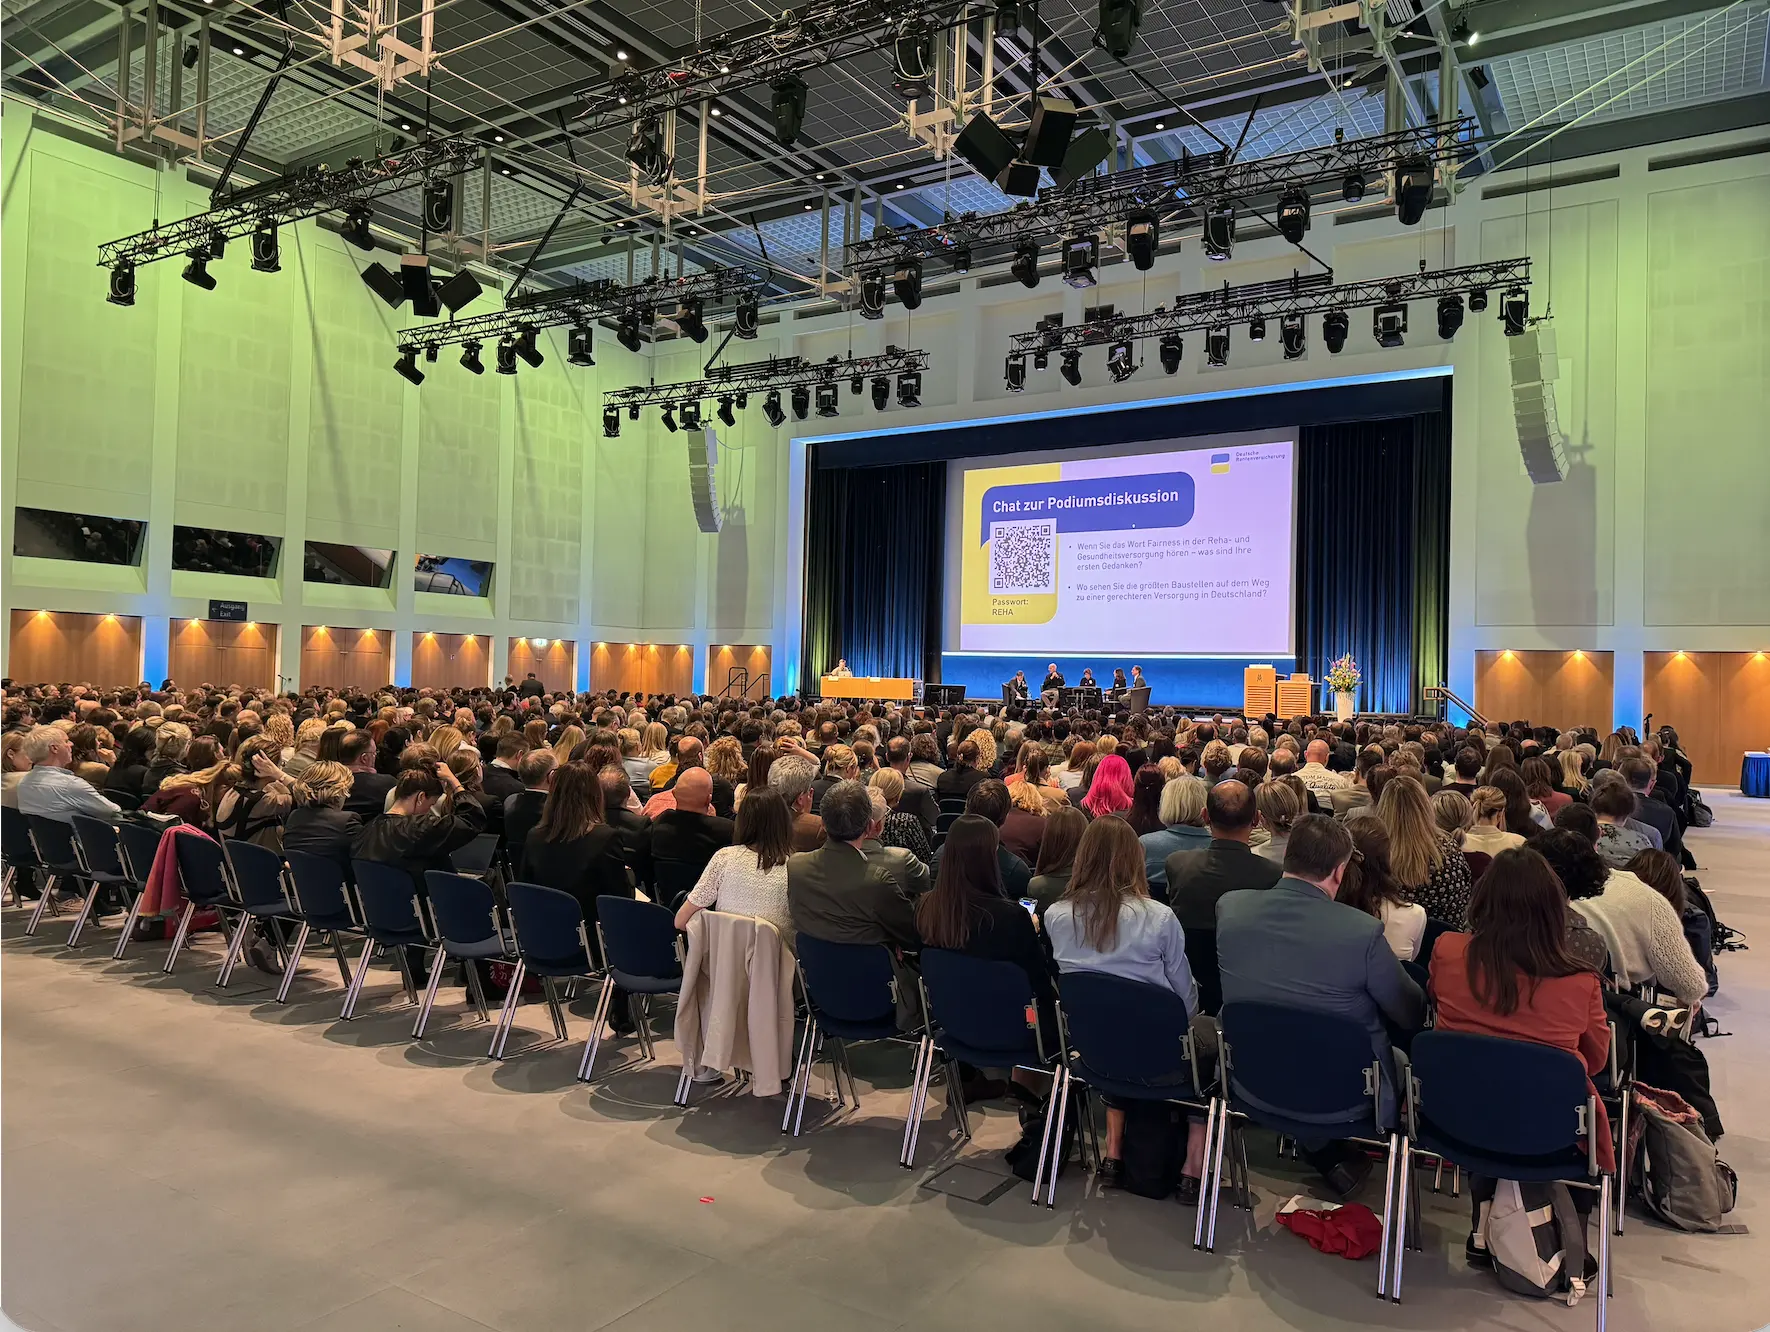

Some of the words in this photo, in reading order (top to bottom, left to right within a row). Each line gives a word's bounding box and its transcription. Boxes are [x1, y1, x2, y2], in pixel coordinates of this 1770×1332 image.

[992, 500, 1021, 513] Chat
[1024, 501, 1044, 512] zur
[1048, 489, 1179, 510] Podiumsdiskussion
[1100, 542, 1110, 550] Sie
[1148, 538, 1180, 547] Fairness
[1208, 536, 1232, 544] Reha-
[1077, 552, 1164, 560] Gesundheitsversorgung
[1216, 546, 1232, 554] sind
[1077, 562, 1100, 570] ersten
[1102, 560, 1142, 570] Gedanken?
[1140, 581, 1169, 591] größten
[1171, 580, 1214, 588] Baustellen
[1251, 578, 1270, 588] Weg
[1106, 592, 1152, 602] gerechteren
[1154, 591, 1199, 600] Versorgung
[1201, 590, 1208, 598] in
[1210, 590, 1267, 598] Deutschland?
